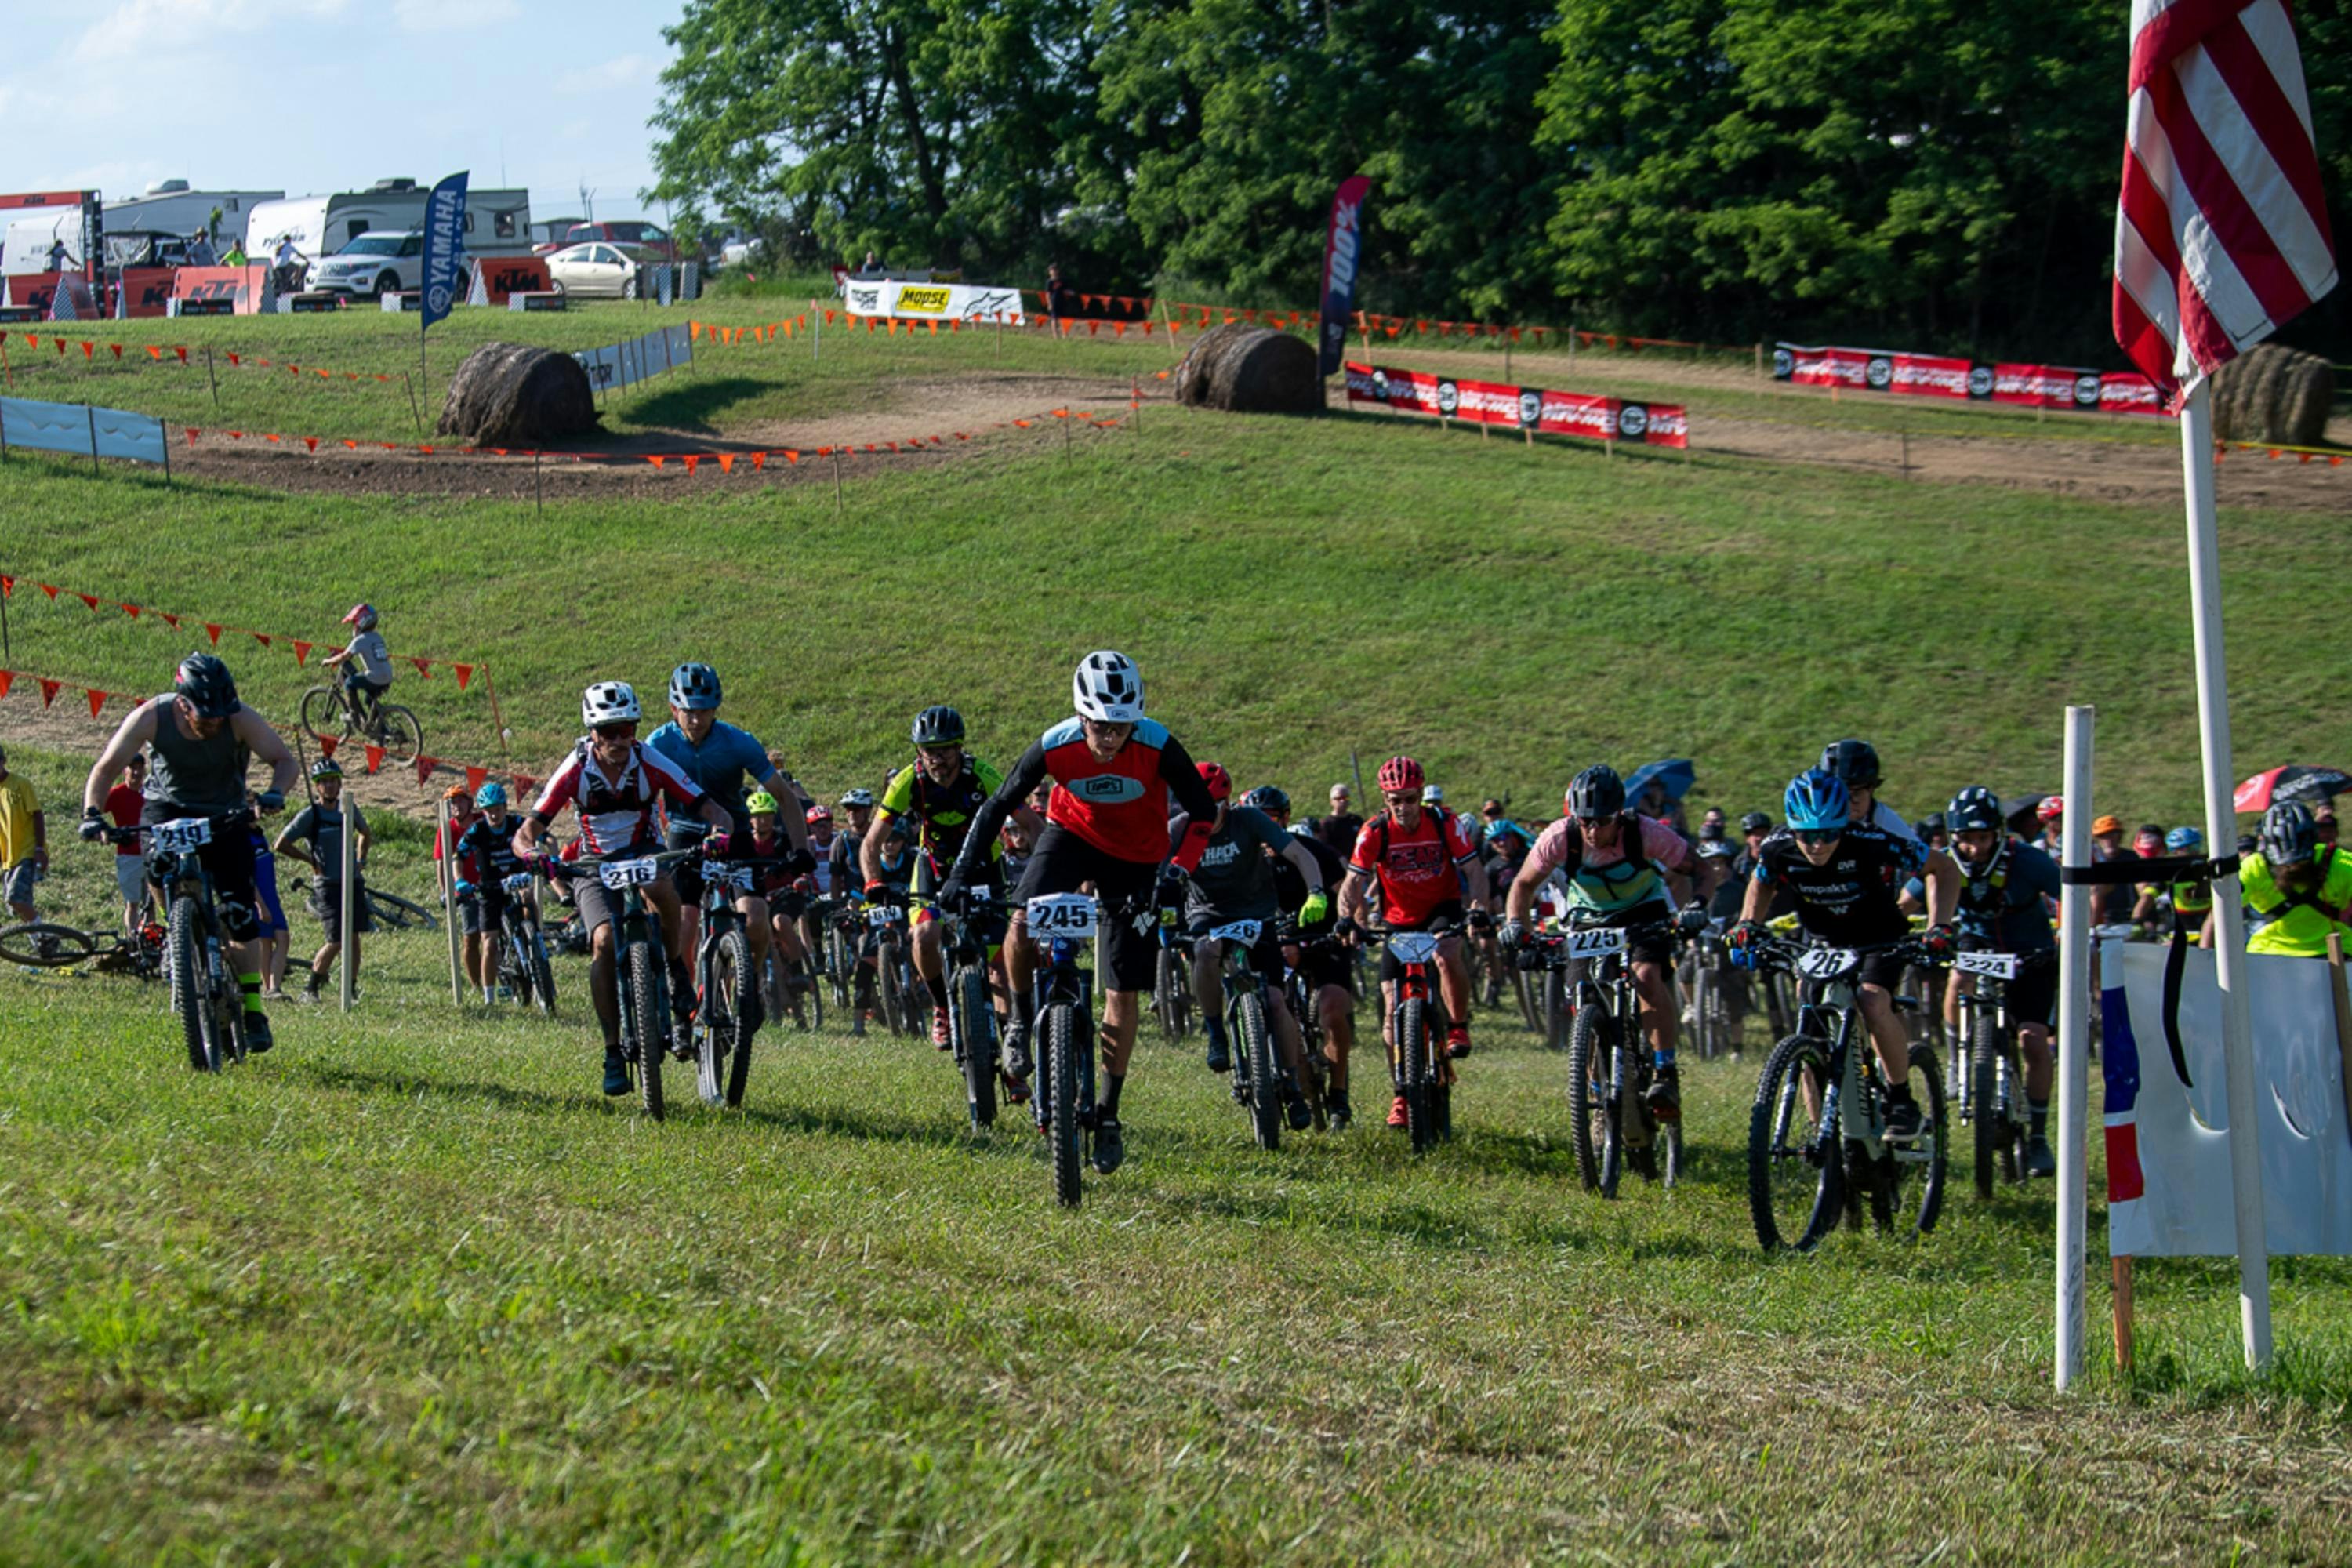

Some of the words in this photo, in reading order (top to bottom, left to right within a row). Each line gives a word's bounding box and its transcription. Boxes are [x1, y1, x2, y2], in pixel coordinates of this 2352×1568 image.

[430, 189, 457, 284] YAMAHA
[1330, 198, 1359, 298] 100%
[494, 268, 540, 293] KTM
[902, 289, 946, 305] MOOSE
[161, 825, 202, 850] 219
[608, 866, 650, 886] 216
[1798, 882, 1849, 894] impakt
[1034, 905, 1088, 928] 245
[1217, 924, 1256, 939] 226
[1573, 930, 1618, 951] 225
[1809, 951, 1845, 975] 26
[1963, 959, 2006, 974] 224
